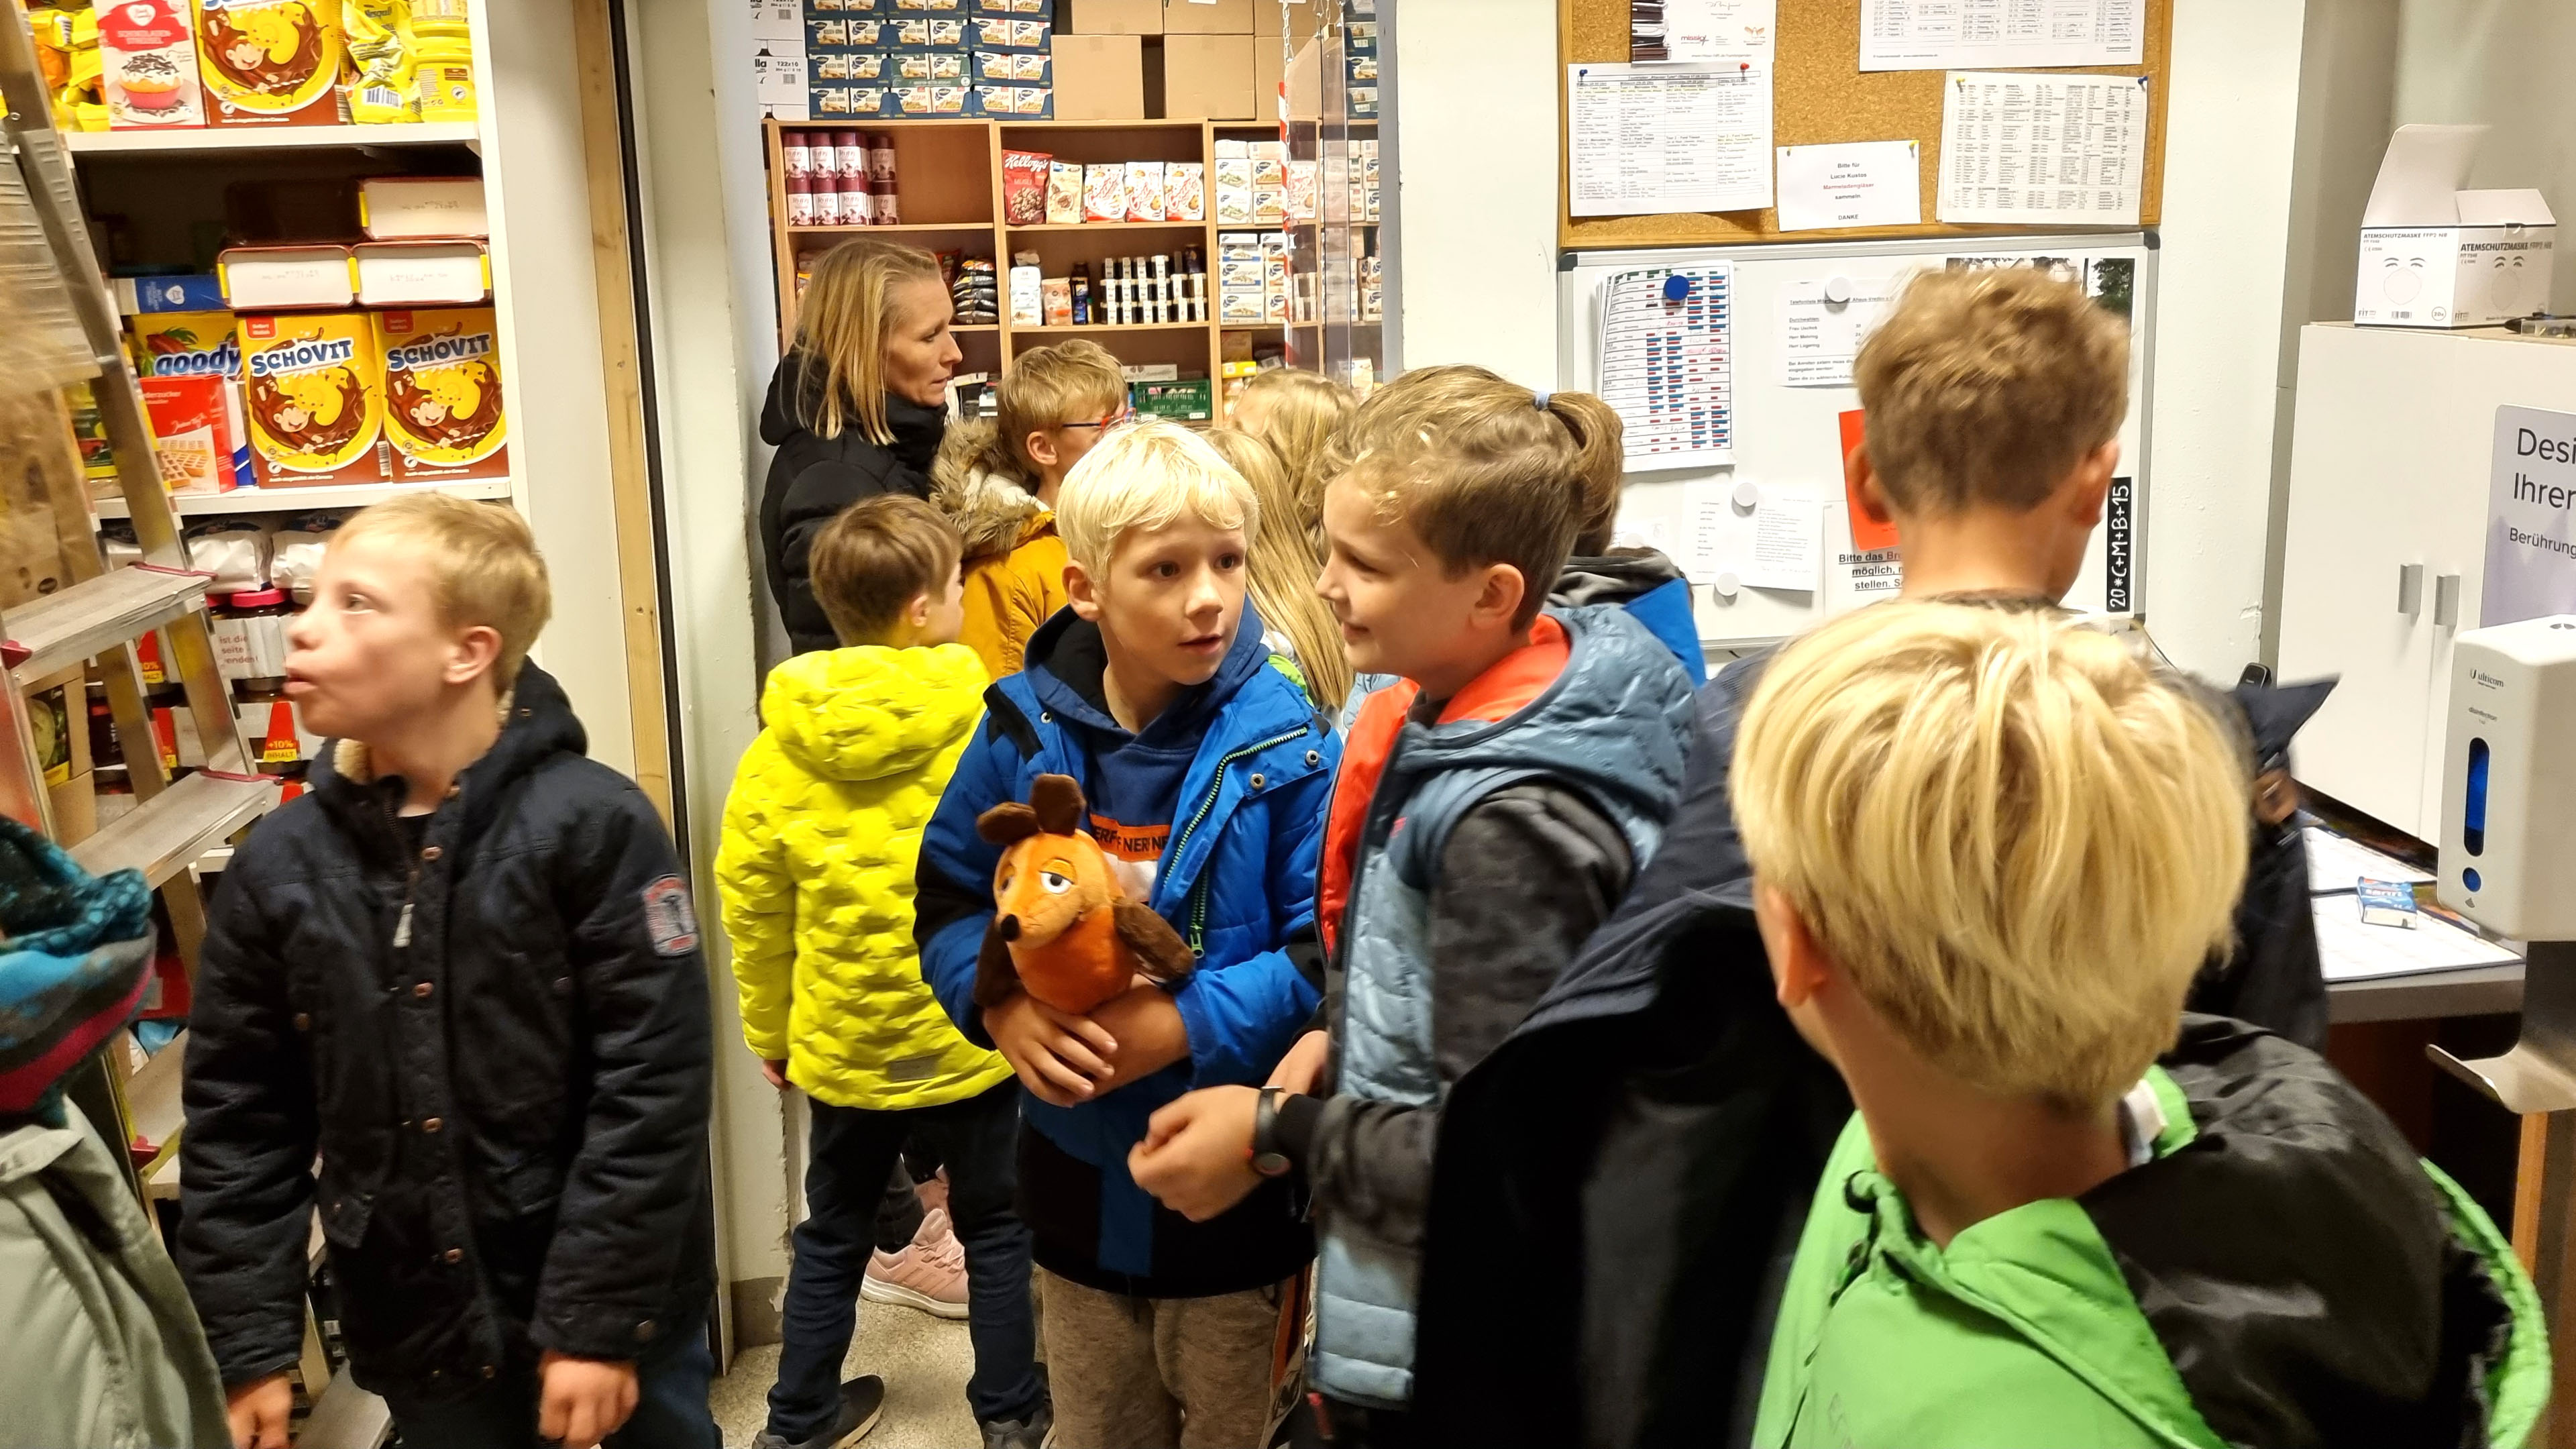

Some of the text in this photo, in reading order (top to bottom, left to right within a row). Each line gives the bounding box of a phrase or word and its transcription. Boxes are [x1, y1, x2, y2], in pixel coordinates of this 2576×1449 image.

[1005, 154, 1049, 172] Kellogg's
[2460, 242, 2529, 252] ATEMSCHUTZMASKE
[250, 339, 352, 374] SCHOVIT
[388, 334, 490, 369] SCHOVIT
[155, 342, 242, 377] goody
[1839, 553, 1862, 562] Bitte
[1865, 553, 1883, 561] das
[1852, 566, 1895, 576] möglich,
[1855, 580, 1890, 590] stellen.
[268, 740, 294, 749] +10%
[266, 751, 294, 759] INHALT
